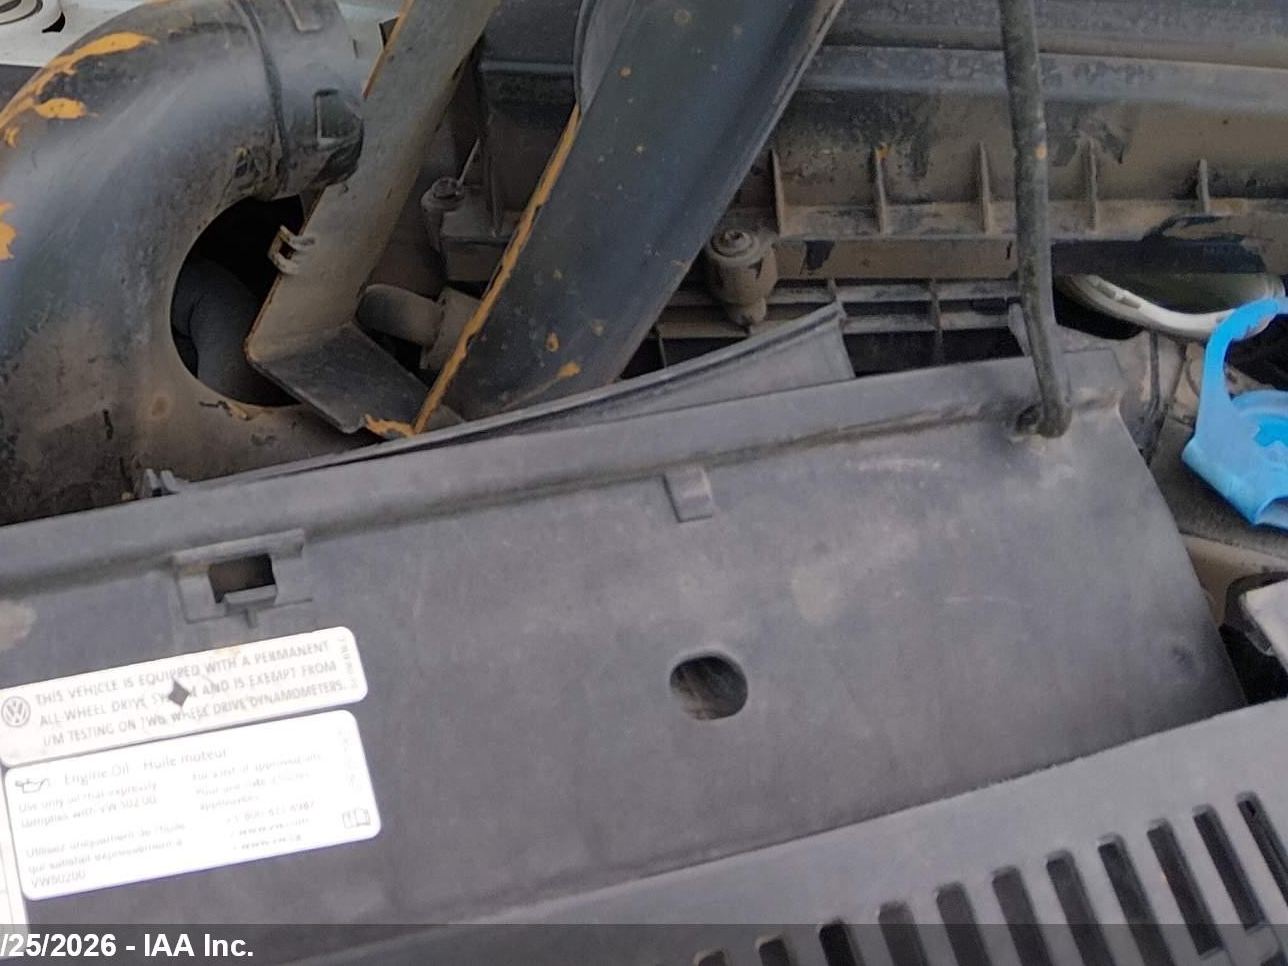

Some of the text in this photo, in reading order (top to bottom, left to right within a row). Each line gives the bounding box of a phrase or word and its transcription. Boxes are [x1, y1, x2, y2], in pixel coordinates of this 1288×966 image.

[36, 641, 329, 706] THIS VEHICLE IS EQUIPPED WITH A PERMANENT
[40, 704, 107, 727] ALL-WHEEL
[112, 698, 147, 712] DRIVE
[202, 681, 230, 695] AND
[233, 678, 244, 690] IS
[249, 670, 296, 688] EXEMPT
[302, 660, 337, 677] FROM
[69, 724, 115, 742] TESTING
[119, 719, 136, 732] ON
[213, 698, 247, 717] DRIVE
[64, 762, 130, 786] Engine Oil
[143, 750, 228, 771] Huile moteur
